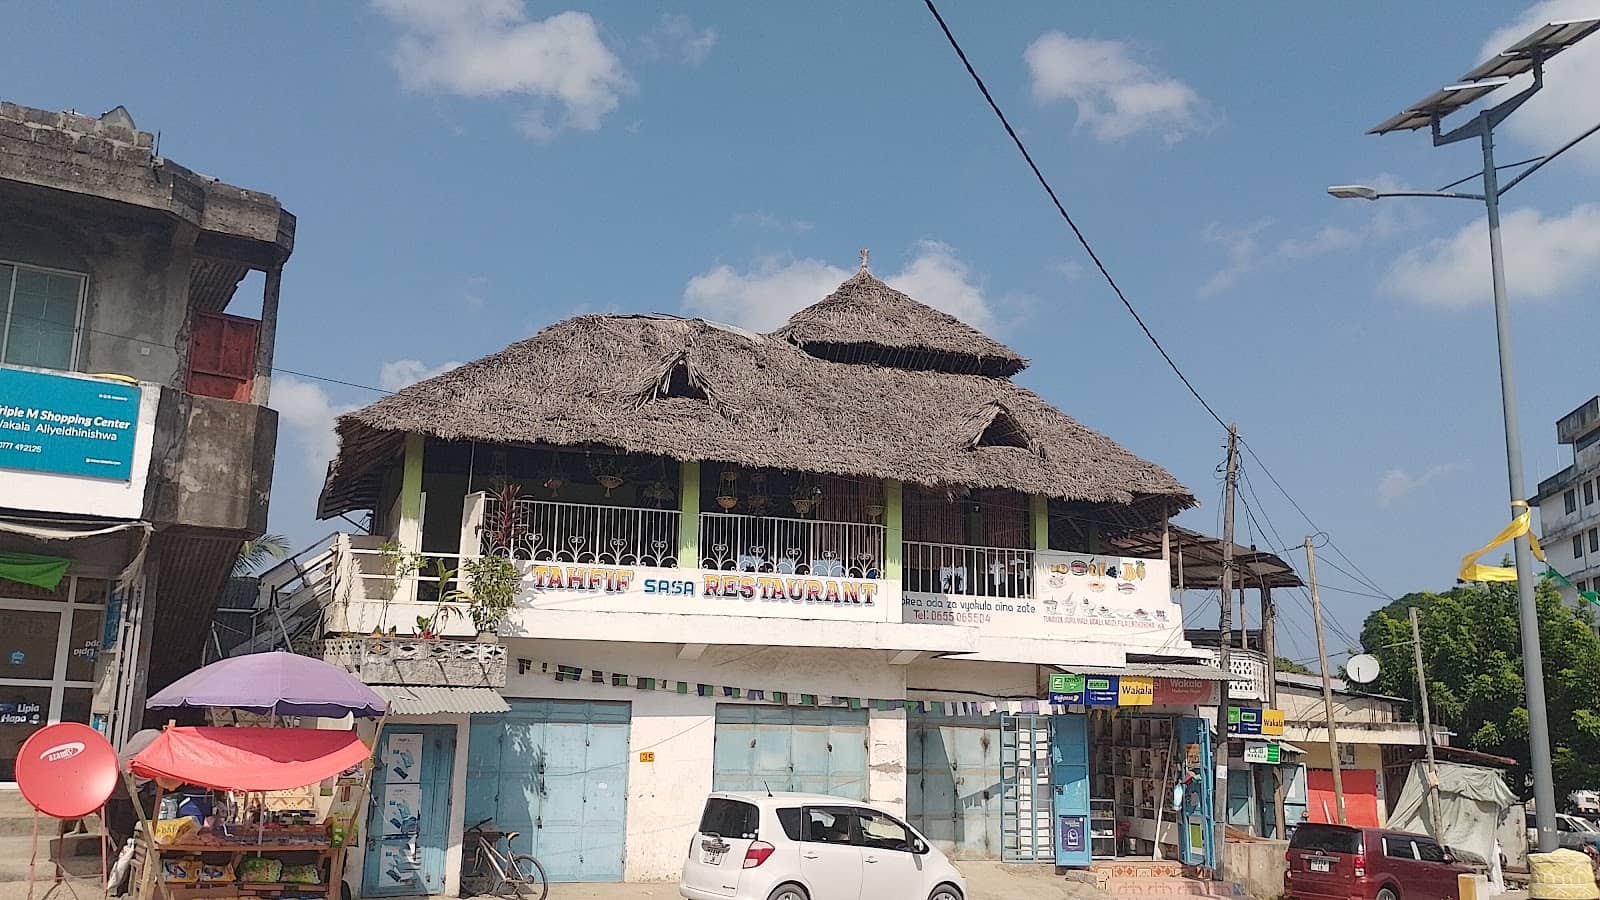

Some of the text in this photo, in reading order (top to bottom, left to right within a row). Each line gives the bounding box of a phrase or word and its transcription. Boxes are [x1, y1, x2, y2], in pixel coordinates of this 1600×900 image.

[0, 404, 130, 429] riple M Shopping Center
[532, 564, 878, 607] TAHFIF SASA RESTAURANT
[1169, 679, 1203, 689] Wakala
[1121, 685, 1153, 695] Wakala
[17, 703, 40, 714] Lipia
